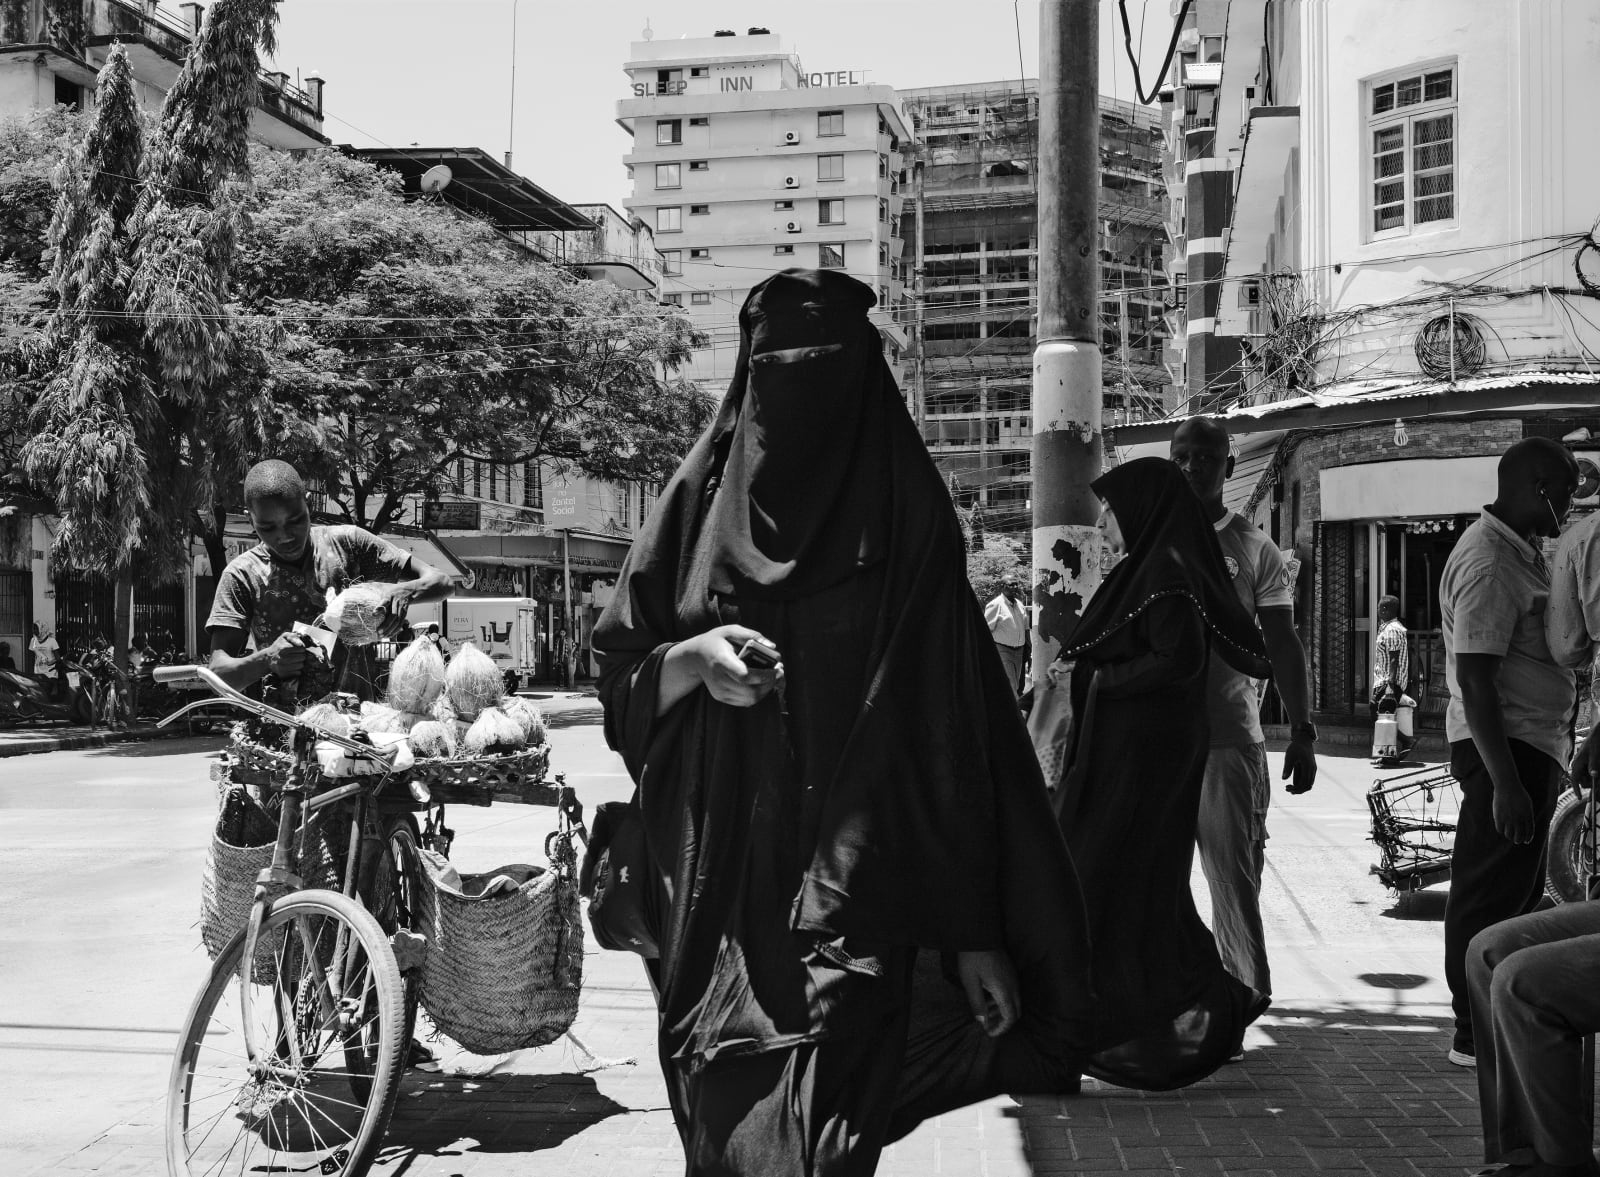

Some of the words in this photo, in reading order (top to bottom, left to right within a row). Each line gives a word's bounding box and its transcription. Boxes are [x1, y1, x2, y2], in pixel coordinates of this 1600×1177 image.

[633, 80, 687, 98] SLEEP
[720, 76, 753, 93] INN
[797, 71, 858, 88] HOTEL
[551, 496, 576, 506] Zantel
[552, 505, 575, 515] Social
